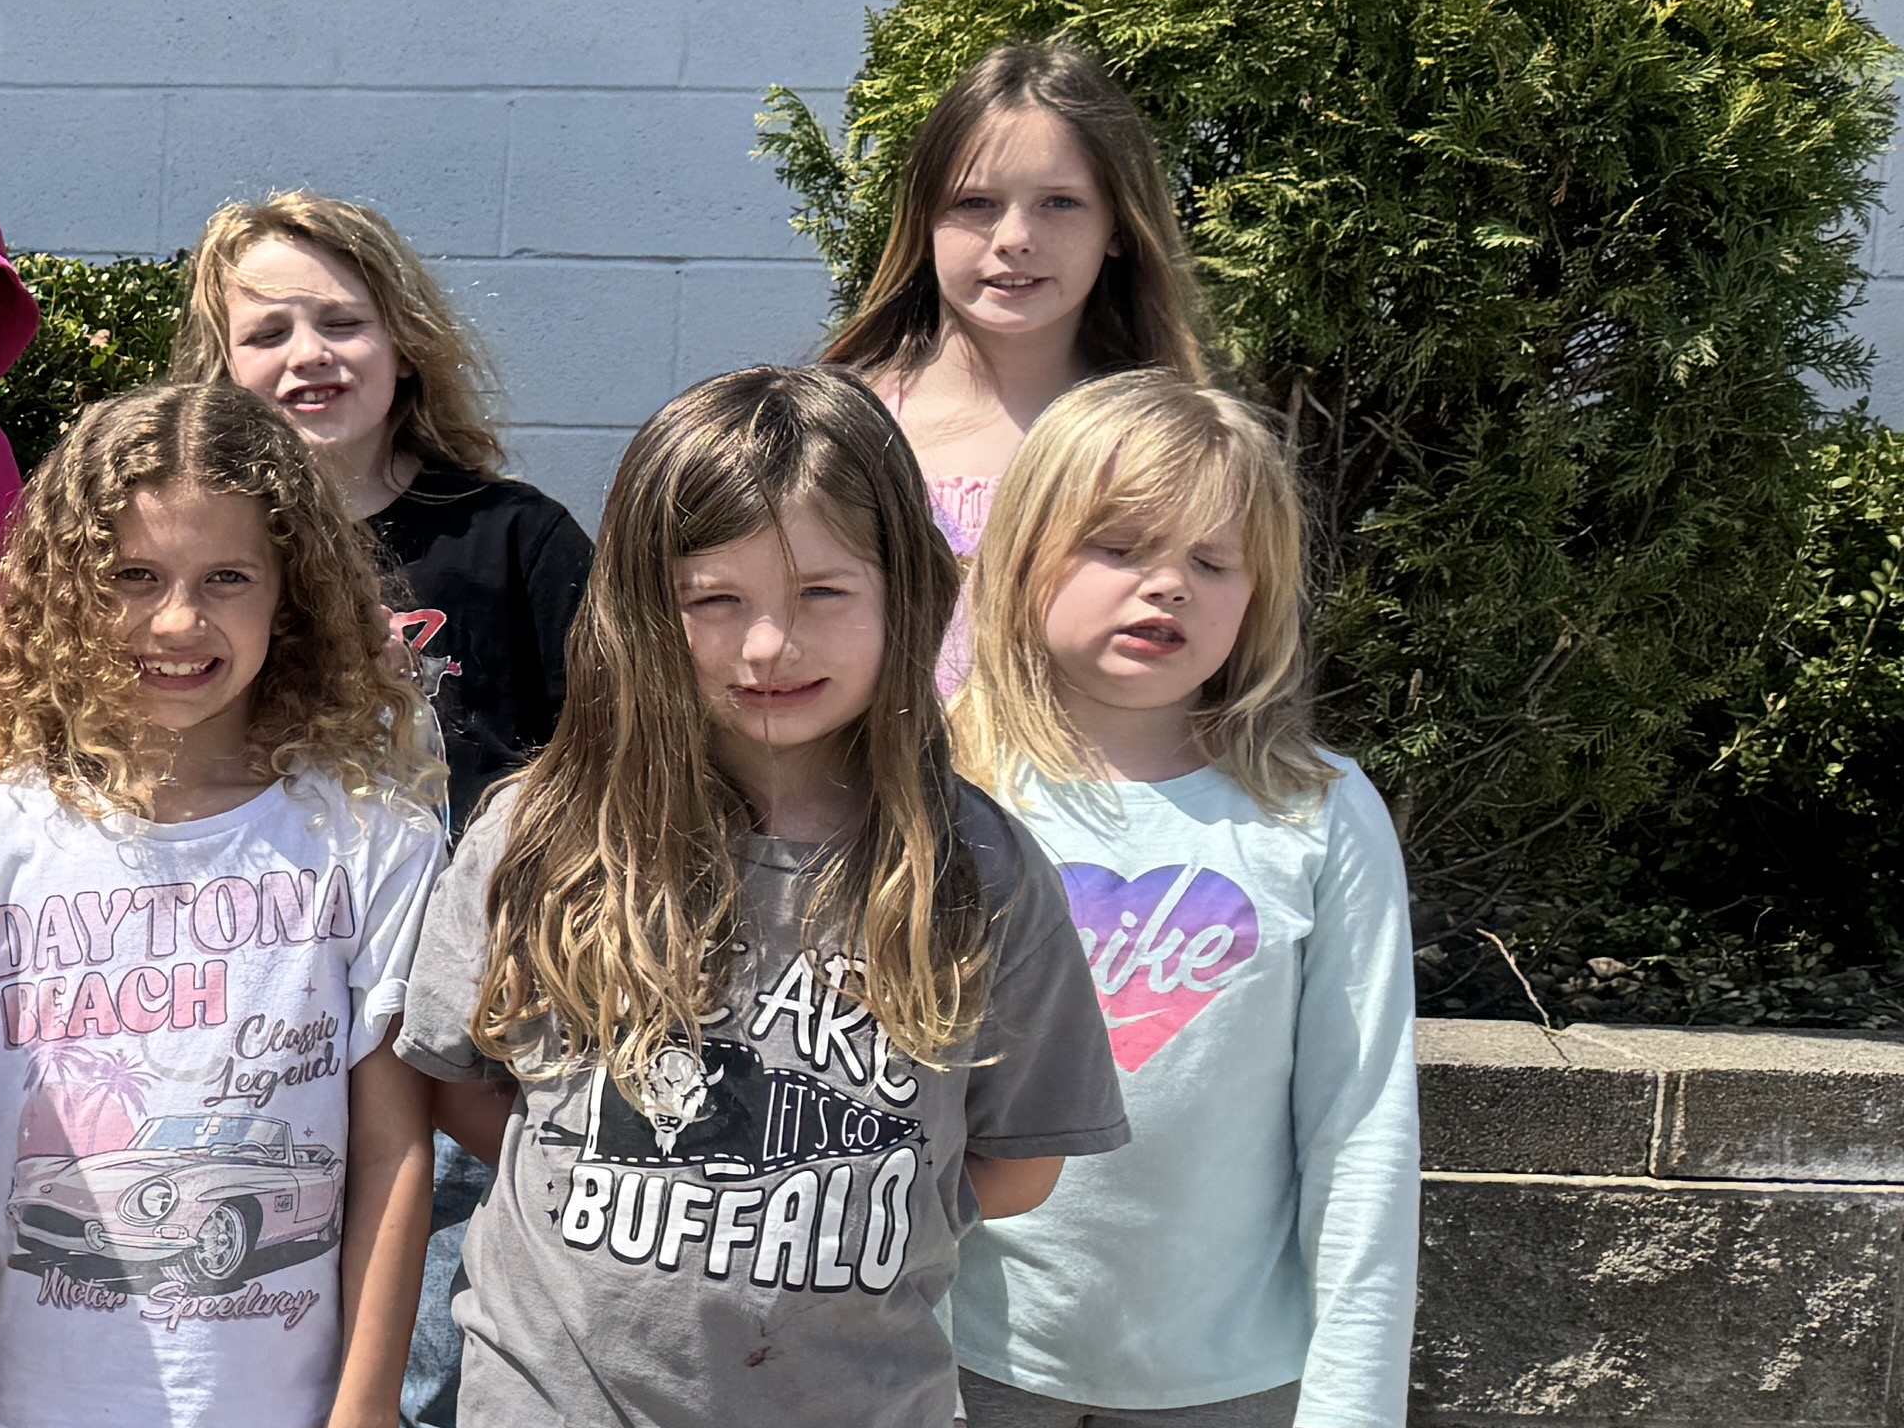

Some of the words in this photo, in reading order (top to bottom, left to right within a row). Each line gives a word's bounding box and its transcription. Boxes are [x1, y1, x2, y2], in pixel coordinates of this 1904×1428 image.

[235, 1009, 341, 1060] Classic
[203, 1042, 342, 1109] Legend
[762, 1079, 830, 1162] LET'S
[840, 1106, 881, 1148] GO
[560, 1145, 919, 1296] BUFFALO
[37, 1266, 127, 1312] Motor
[141, 1280, 320, 1332] Speedway
